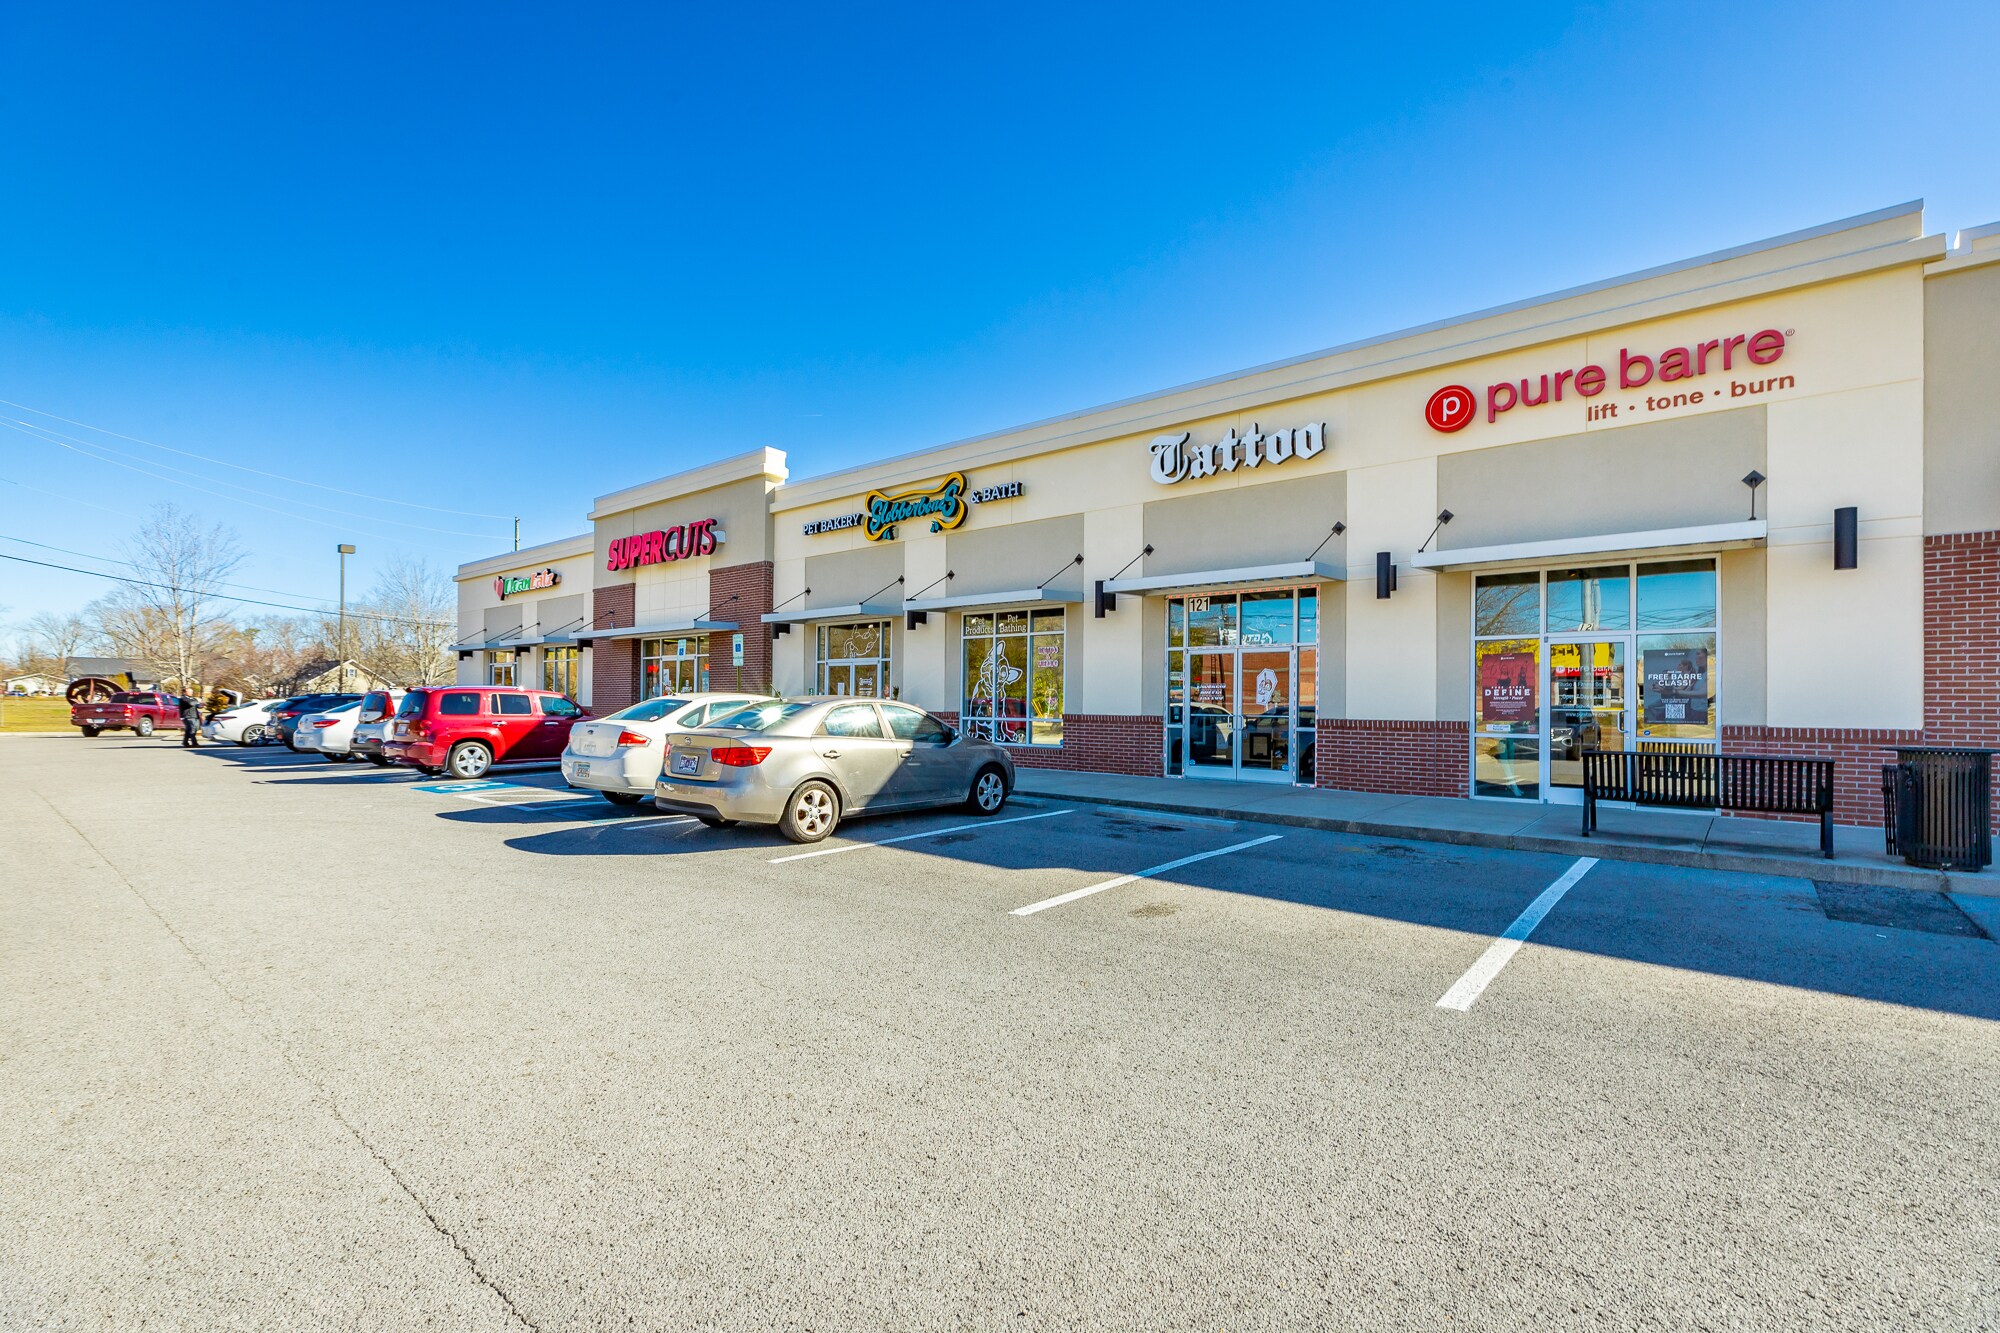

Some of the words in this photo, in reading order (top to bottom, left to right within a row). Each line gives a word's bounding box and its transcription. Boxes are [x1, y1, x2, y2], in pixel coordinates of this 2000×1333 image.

[1487, 365, 1606, 424] pure
[1620, 329, 1785, 389] barre
[1442, 396, 1460, 422] p
[1587, 403, 1618, 422] lift
[1646, 390, 1704, 411] tone
[1730, 375, 1795, 398] burn
[1150, 422, 1327, 485] Tattoo
[970, 491, 980, 503] &
[982, 481, 1020, 501] BATH
[802, 524, 819, 535] PET
[821, 513, 861, 532] BAKERY
[607, 518, 717, 571] SUPERCUTS
[1190, 598, 1209, 612] 121
[965, 625, 994, 634] Products
[974, 617, 985, 625] Pet
[1000, 624, 1026, 633] Bathing
[1007, 614, 1018, 623] Pet
[1485, 688, 1530, 696] DEFINE
